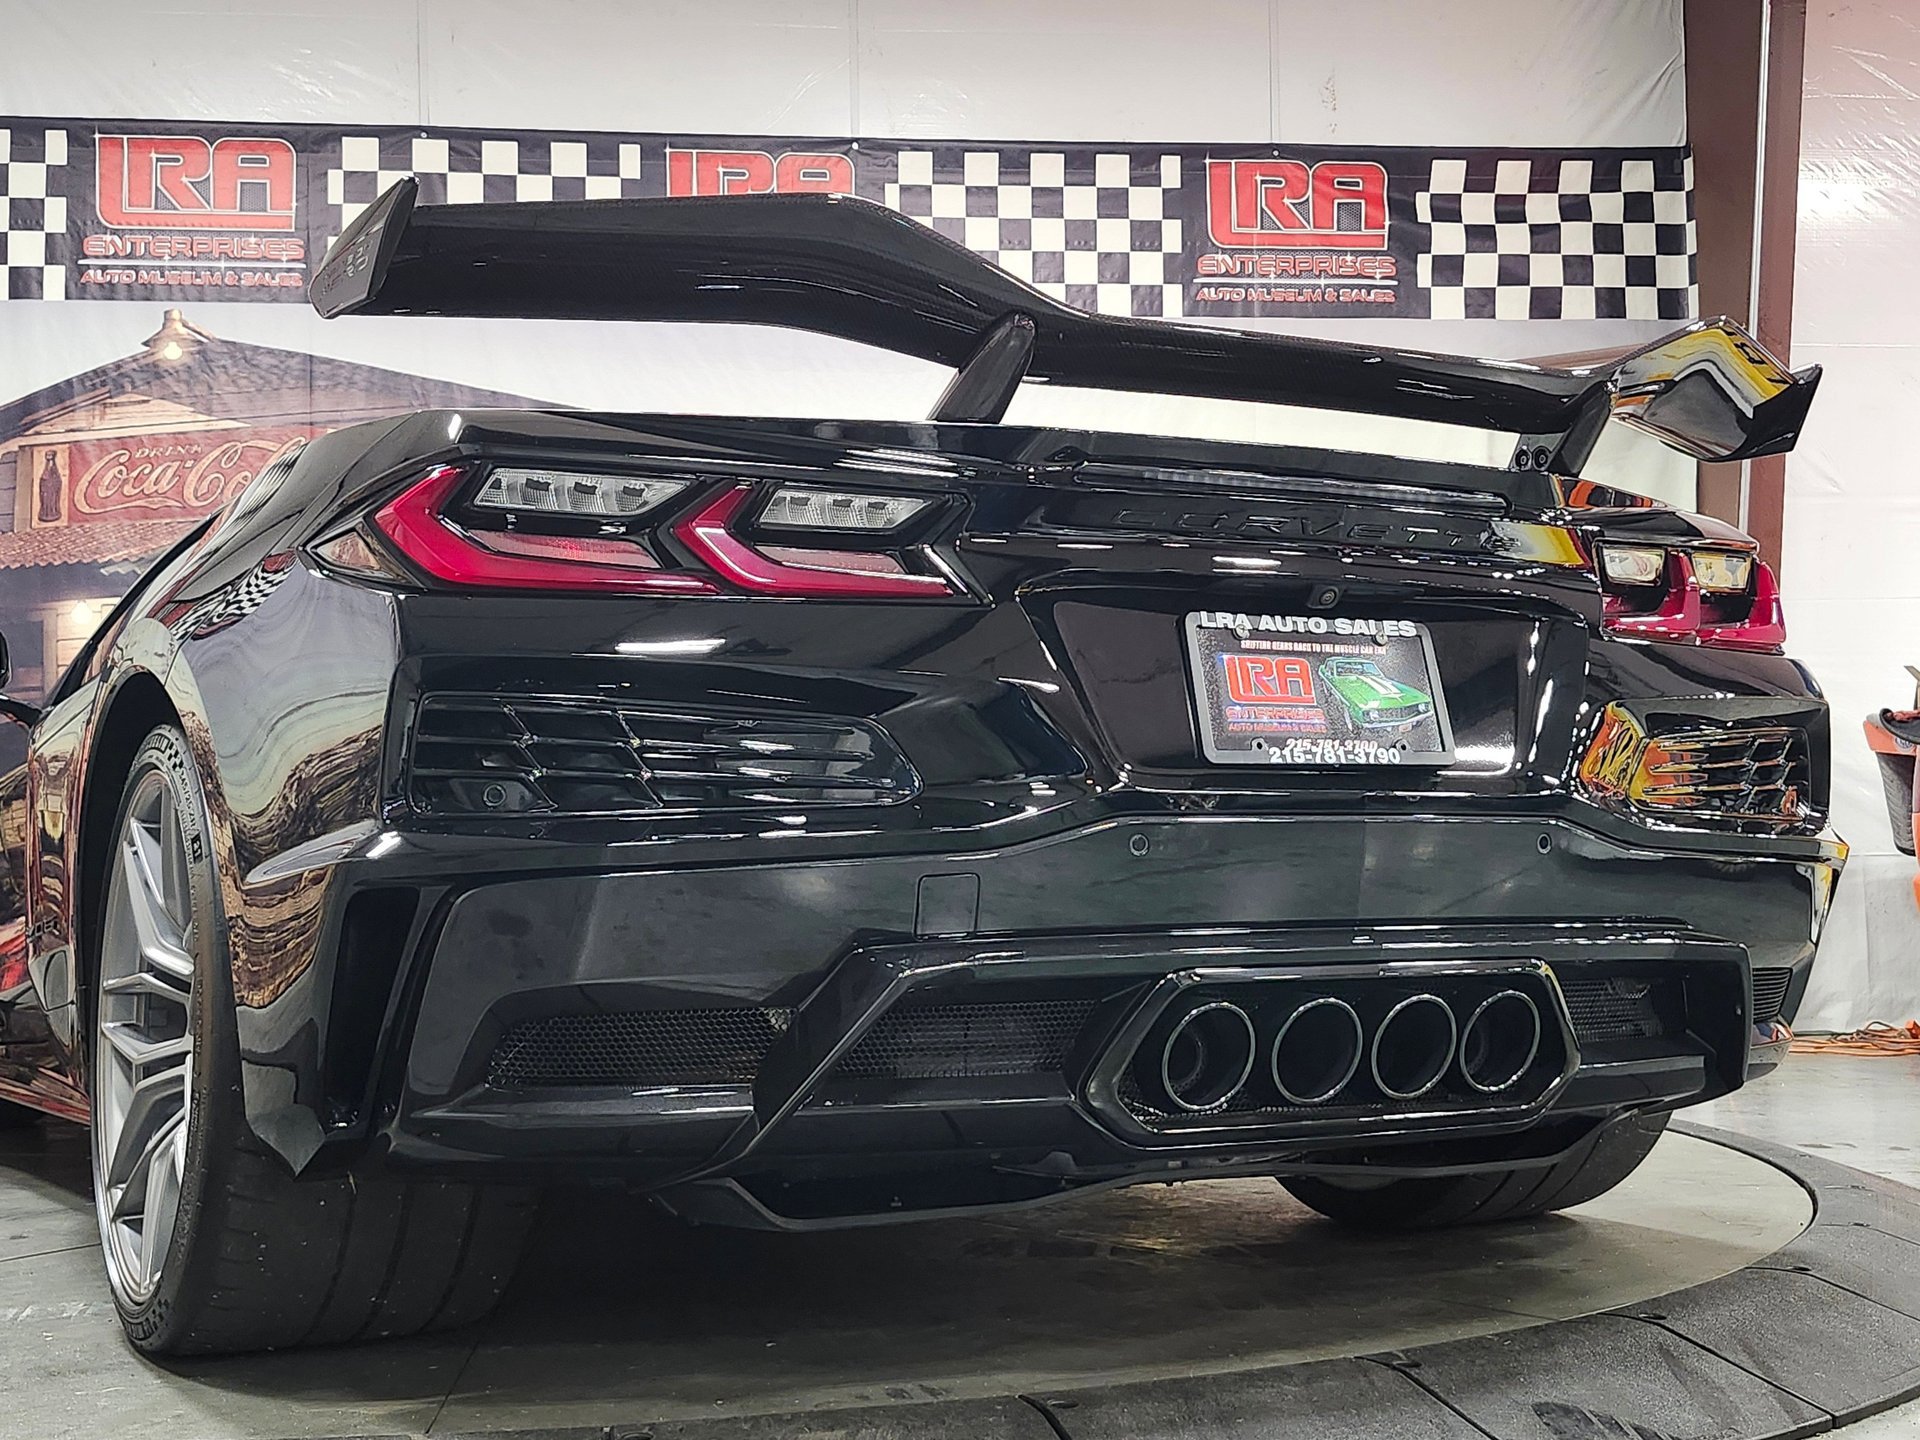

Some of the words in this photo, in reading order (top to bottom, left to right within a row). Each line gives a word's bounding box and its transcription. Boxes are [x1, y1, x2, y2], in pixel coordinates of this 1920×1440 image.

[96, 134, 297, 231] LRA
[1206, 159, 1389, 250] LRA
[82, 234, 305, 260] ENTERPRISES
[80, 269, 136, 285] AUTO
[138, 270, 221, 286] MUSEUM
[224, 271, 239, 286] &
[241, 272, 304, 287] SALES
[1196, 254, 1397, 277] ENTERPRISES
[1196, 287, 1246, 301] AUTO
[1247, 288, 1322, 302] MUSEUM
[1324, 288, 1337, 302] &
[1339, 289, 1396, 302] SALES
[134, 444, 202, 458] DRINK
[74, 436, 306, 514] Coca-Co
[1200, 611, 1252, 630] LRA
[1258, 614, 1329, 635] AUTO
[1334, 617, 1417, 637] SALES
[1222, 655, 1317, 705] LRA
[1268, 747, 1401, 763] 215-781-3790
